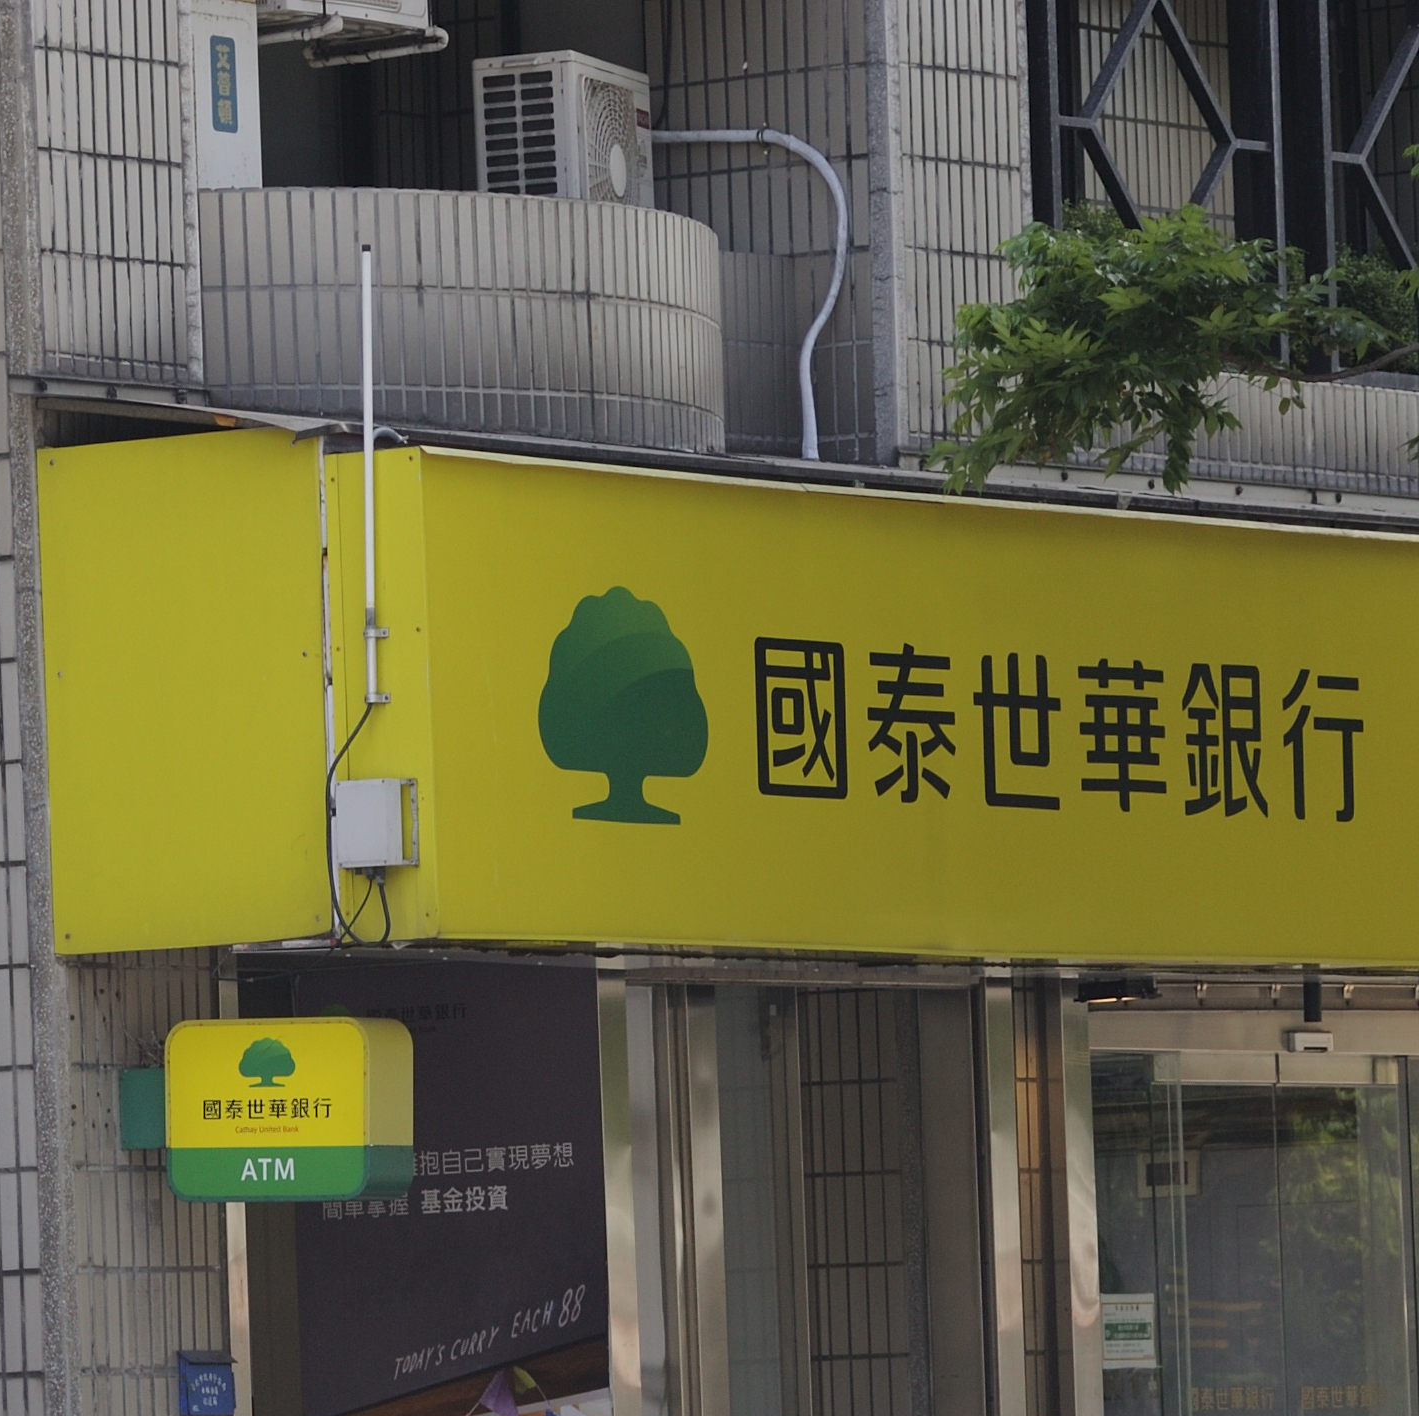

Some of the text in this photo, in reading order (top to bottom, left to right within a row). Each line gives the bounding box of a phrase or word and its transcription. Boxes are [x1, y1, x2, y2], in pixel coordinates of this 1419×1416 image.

[753, 635, 1364, 823] 國泰世華銀行
[202, 1098, 332, 1121] 國泰世華銀行
[235, 1125, 299, 1135] Cathay United Bank
[240, 1157, 295, 1181] ATM
[420, 1184, 509, 1215] 基金投資
[393, 1283, 586, 1381] TODAY'S CURRY EACH 88
